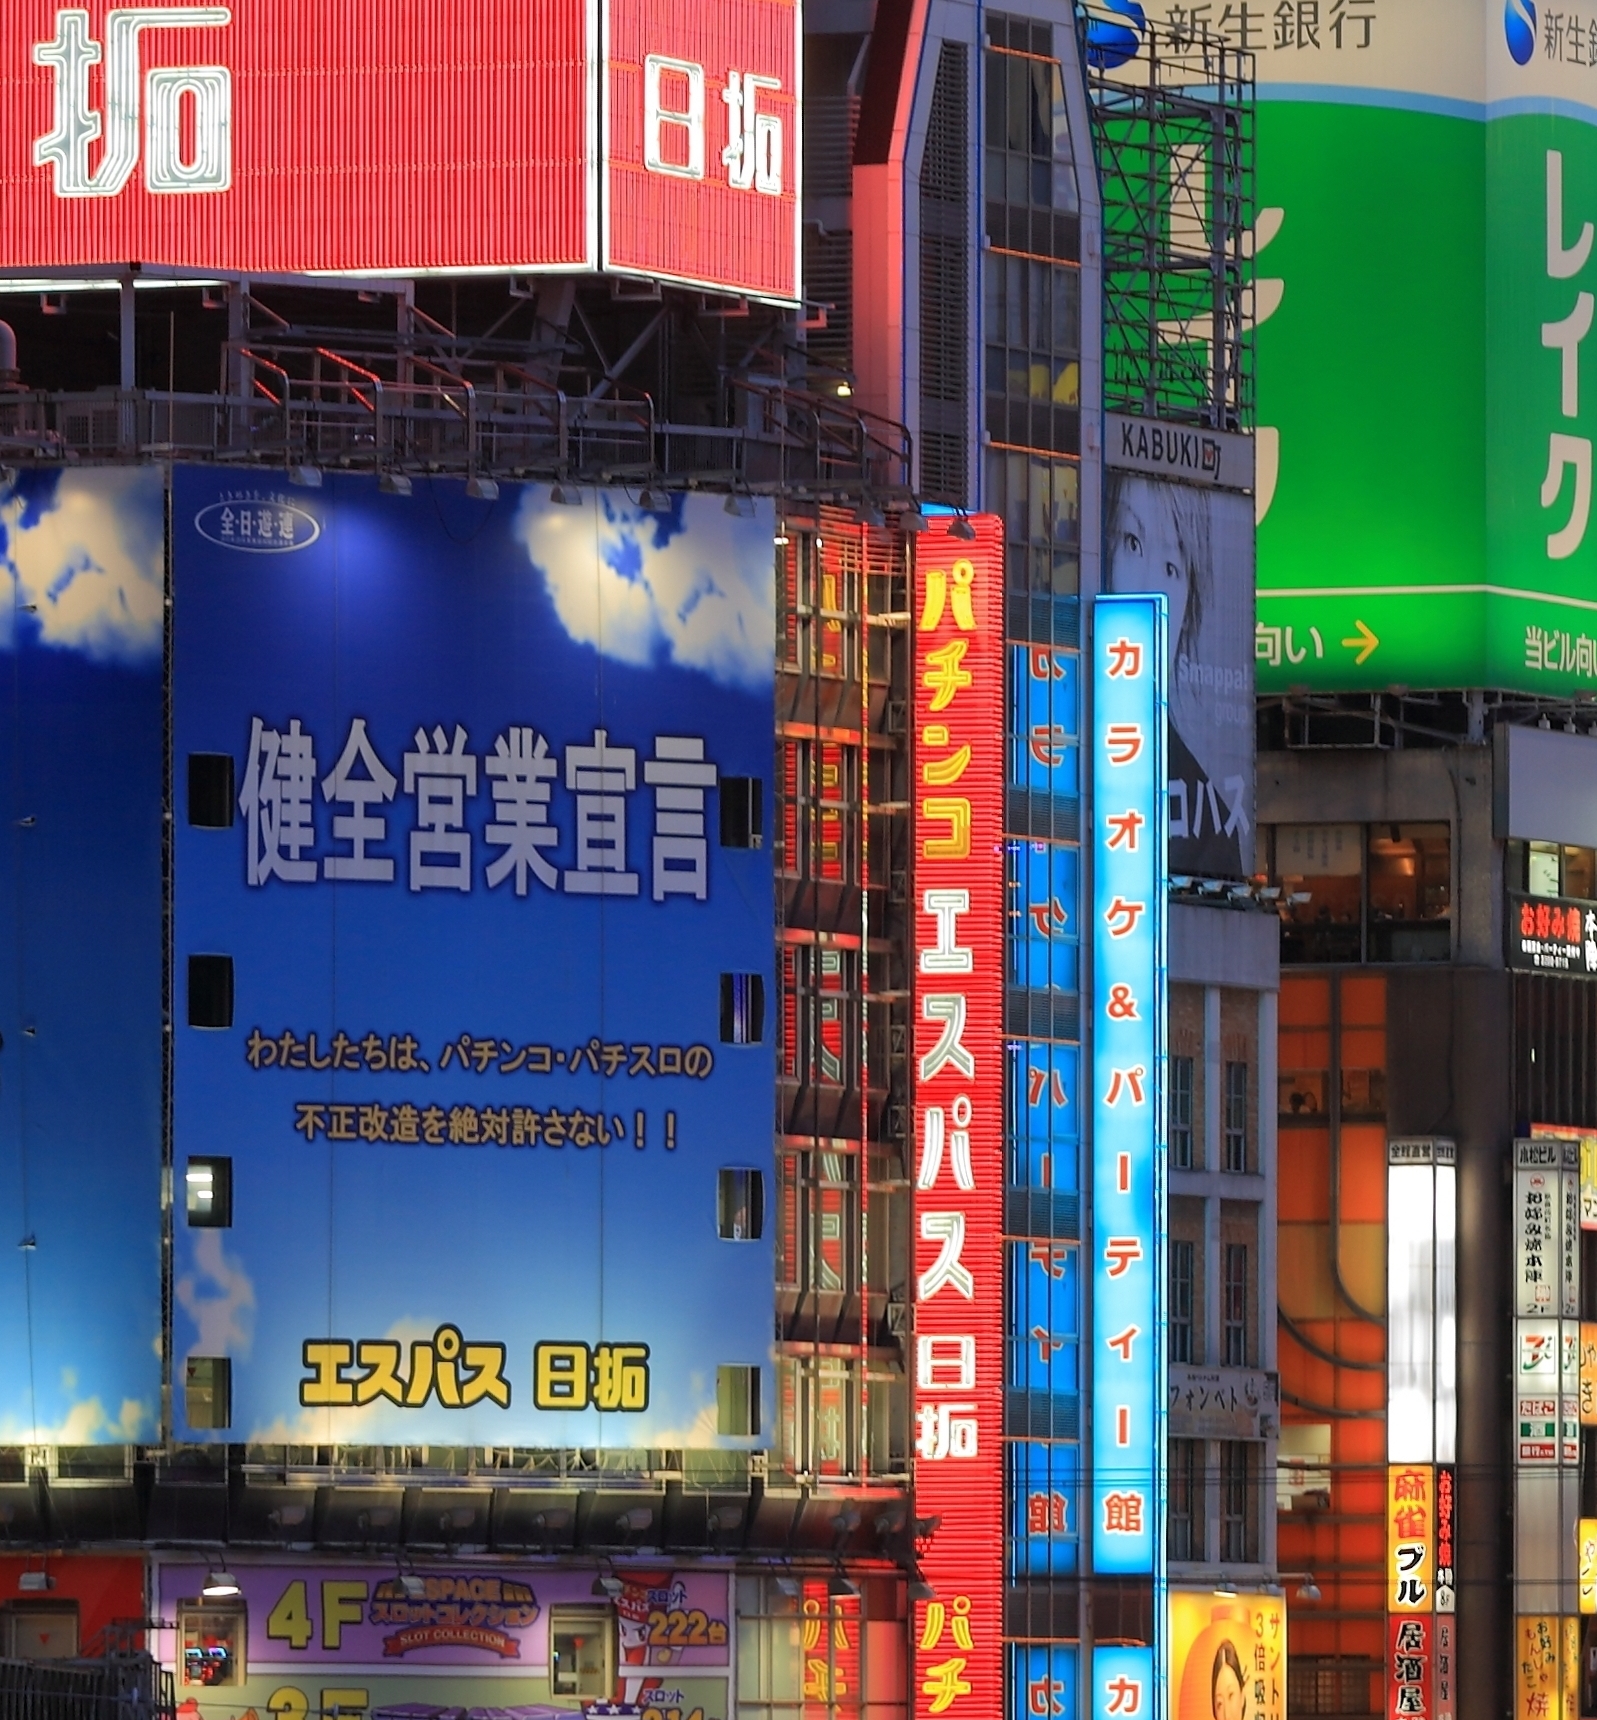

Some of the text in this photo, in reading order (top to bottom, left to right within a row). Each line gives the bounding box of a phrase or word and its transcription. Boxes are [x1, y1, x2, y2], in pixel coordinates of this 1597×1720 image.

[1163, 0, 1378, 52] 新生銀行
[33, 7, 231, 199] 拓
[644, 54, 783, 196] 日拓
[1540, 149, 1596, 560] レイク
[239, 716, 717, 900] 健全営業宣言
[915, 560, 979, 1461] パチンコ エスパス 日拓
[247, 1030, 713, 1078] わたしたちは、パチンコ・パチスロの
[1520, 1147, 1556, 1163] 小松ビル
[301, 1324, 650, 1410] エスパス 日拓
[1394, 1471, 1427, 1539] 麻雀
[267, 1579, 369, 1650] 4F
[1397, 1543, 1427, 1606] ブル
[1396, 1621, 1427, 1715] 居酒屋
